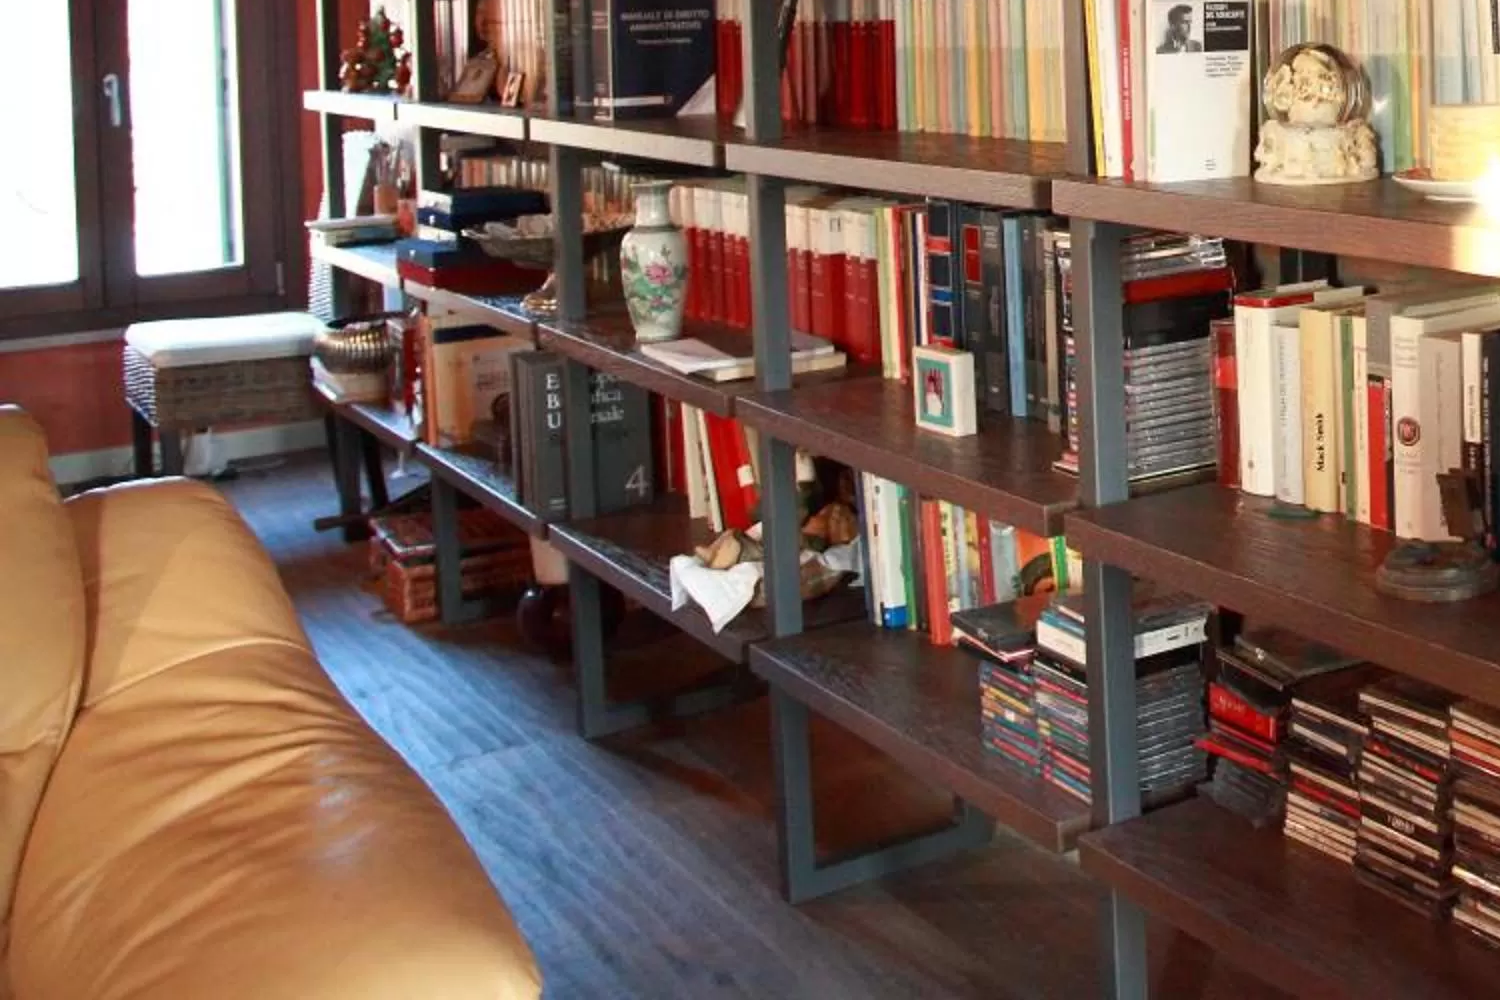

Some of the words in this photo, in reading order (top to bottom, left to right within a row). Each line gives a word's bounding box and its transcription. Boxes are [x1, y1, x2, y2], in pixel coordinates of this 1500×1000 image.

[1313, 413, 1325, 442] Smith
[1314, 445, 1326, 473] Mack
[625, 464, 650, 498] 4
